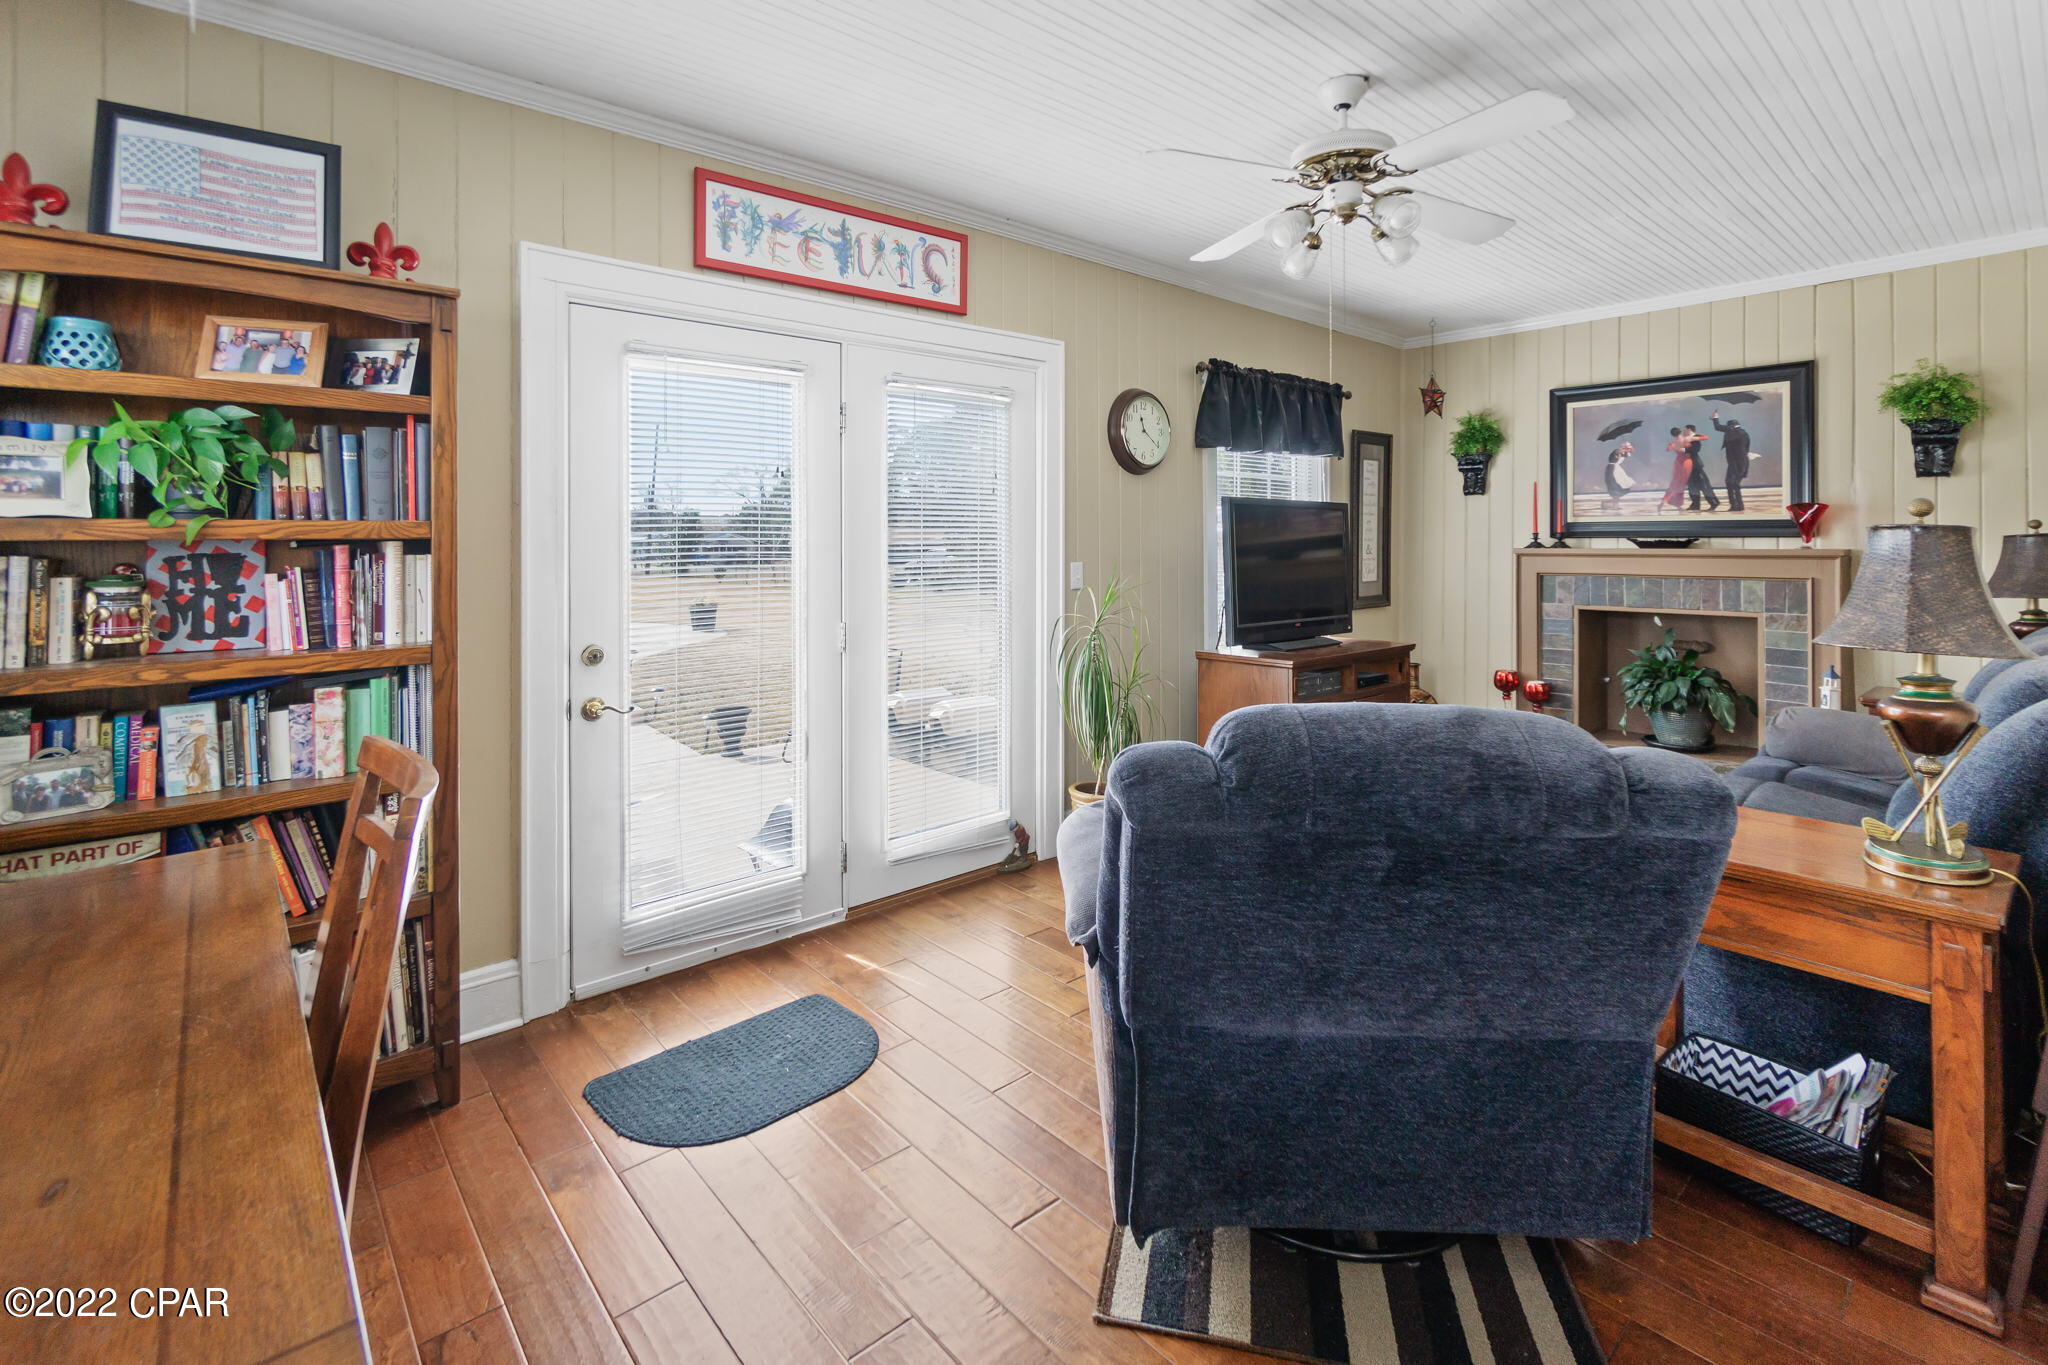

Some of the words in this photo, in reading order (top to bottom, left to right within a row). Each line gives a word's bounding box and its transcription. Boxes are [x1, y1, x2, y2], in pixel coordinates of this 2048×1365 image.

[114, 721, 127, 777] COMPUTER
[51, 845, 110, 867] PART
[116, 840, 144, 856] OF
